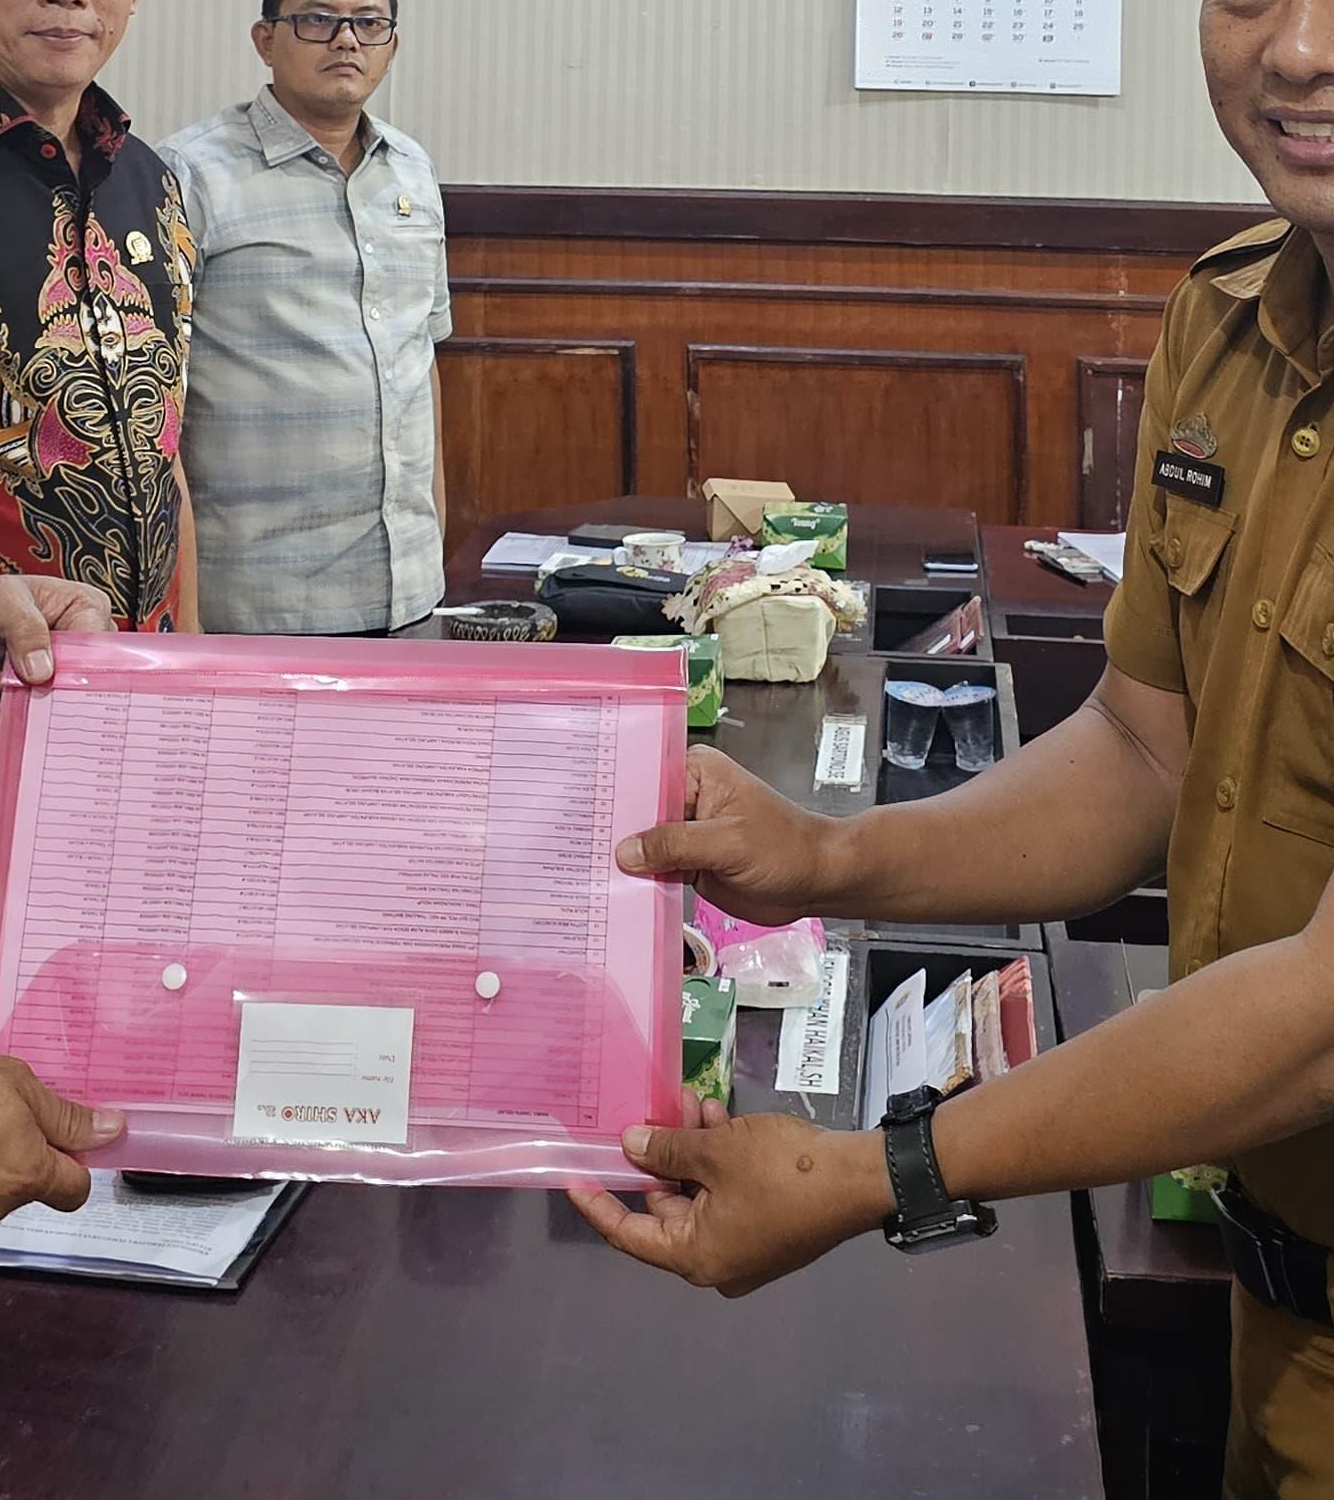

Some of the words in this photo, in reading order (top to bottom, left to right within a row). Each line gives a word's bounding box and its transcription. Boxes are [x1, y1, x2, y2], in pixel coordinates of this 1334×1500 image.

[1158, 463, 1185, 481] ABDUL
[1185, 469, 1212, 489] ROHIM
[281, 1105, 338, 1124] SHIRO
[343, 1107, 381, 1125] AKA
